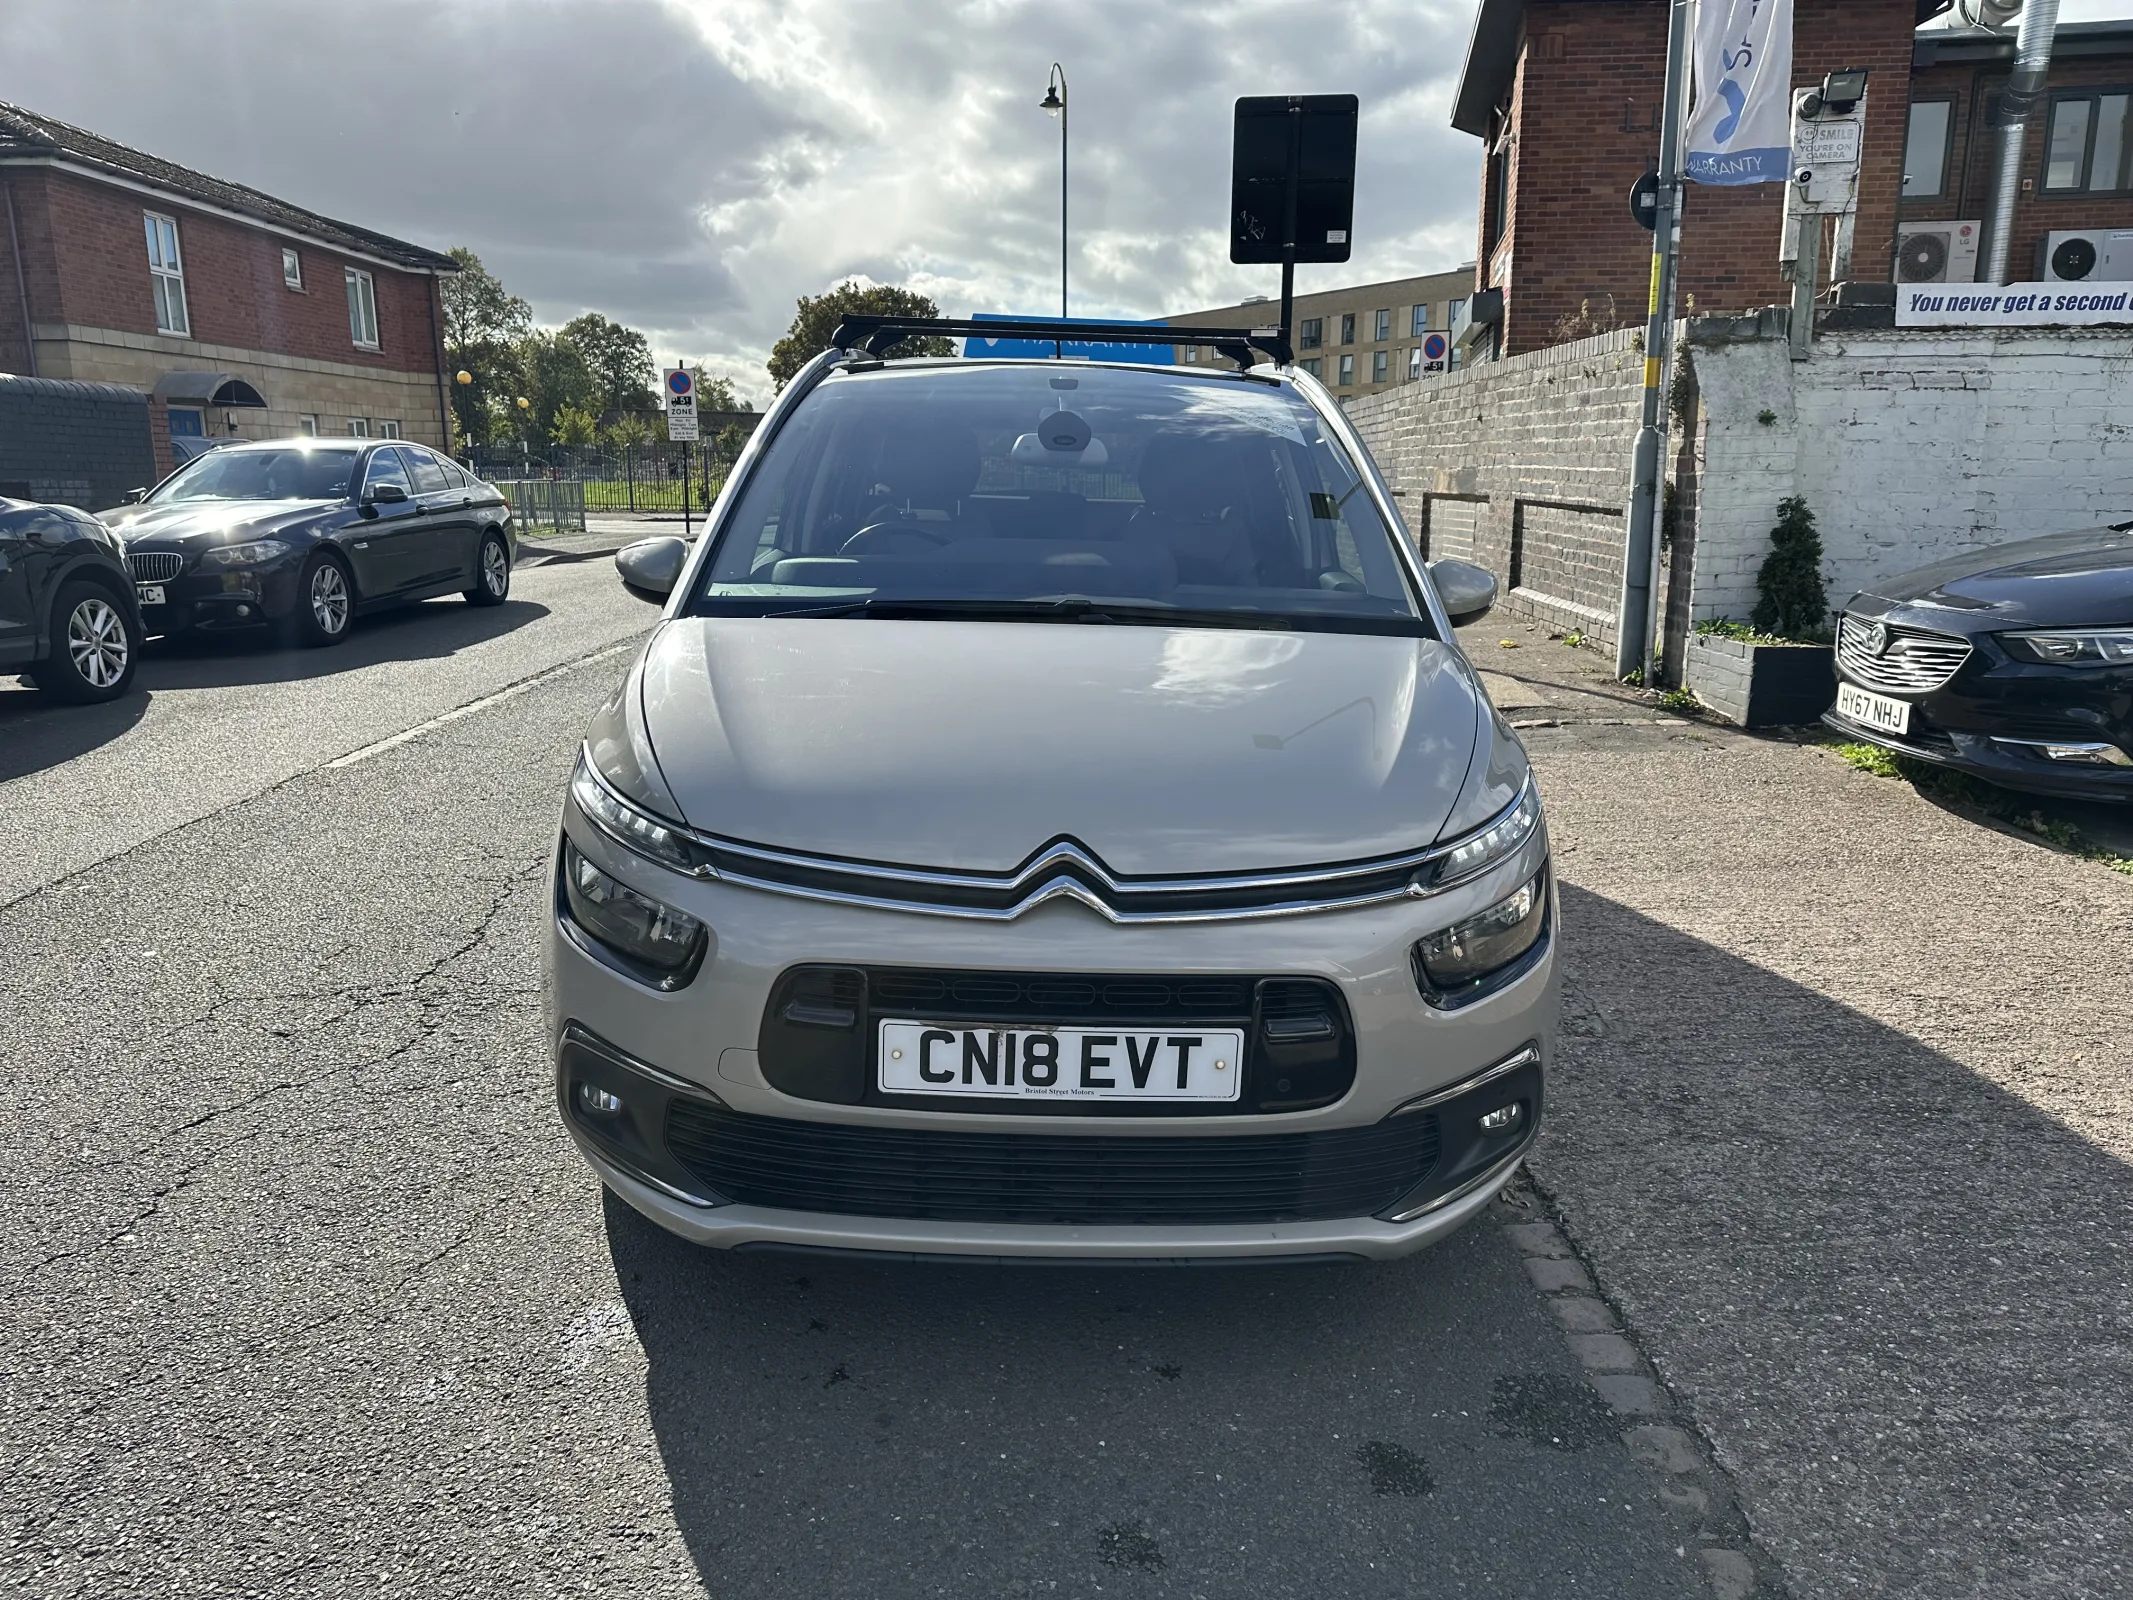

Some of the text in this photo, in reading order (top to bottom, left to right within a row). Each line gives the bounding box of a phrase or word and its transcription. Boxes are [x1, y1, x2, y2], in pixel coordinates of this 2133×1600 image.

[1820, 129, 1853, 140] SMILE
[1800, 143, 1852, 152] YOU'RE ON
[1806, 151, 1845, 159] CAMERA
[1910, 294, 1943, 312] You
[1945, 296, 2002, 312] never
[2002, 294, 2037, 313] get
[2038, 296, 2052, 311] a
[2054, 292, 2128, 311] second
[1841, 688, 1903, 728] HY67 NHJ
[919, 1030, 1203, 1089] CN18 EVT
[1048, 1088, 1069, 1096] Street
